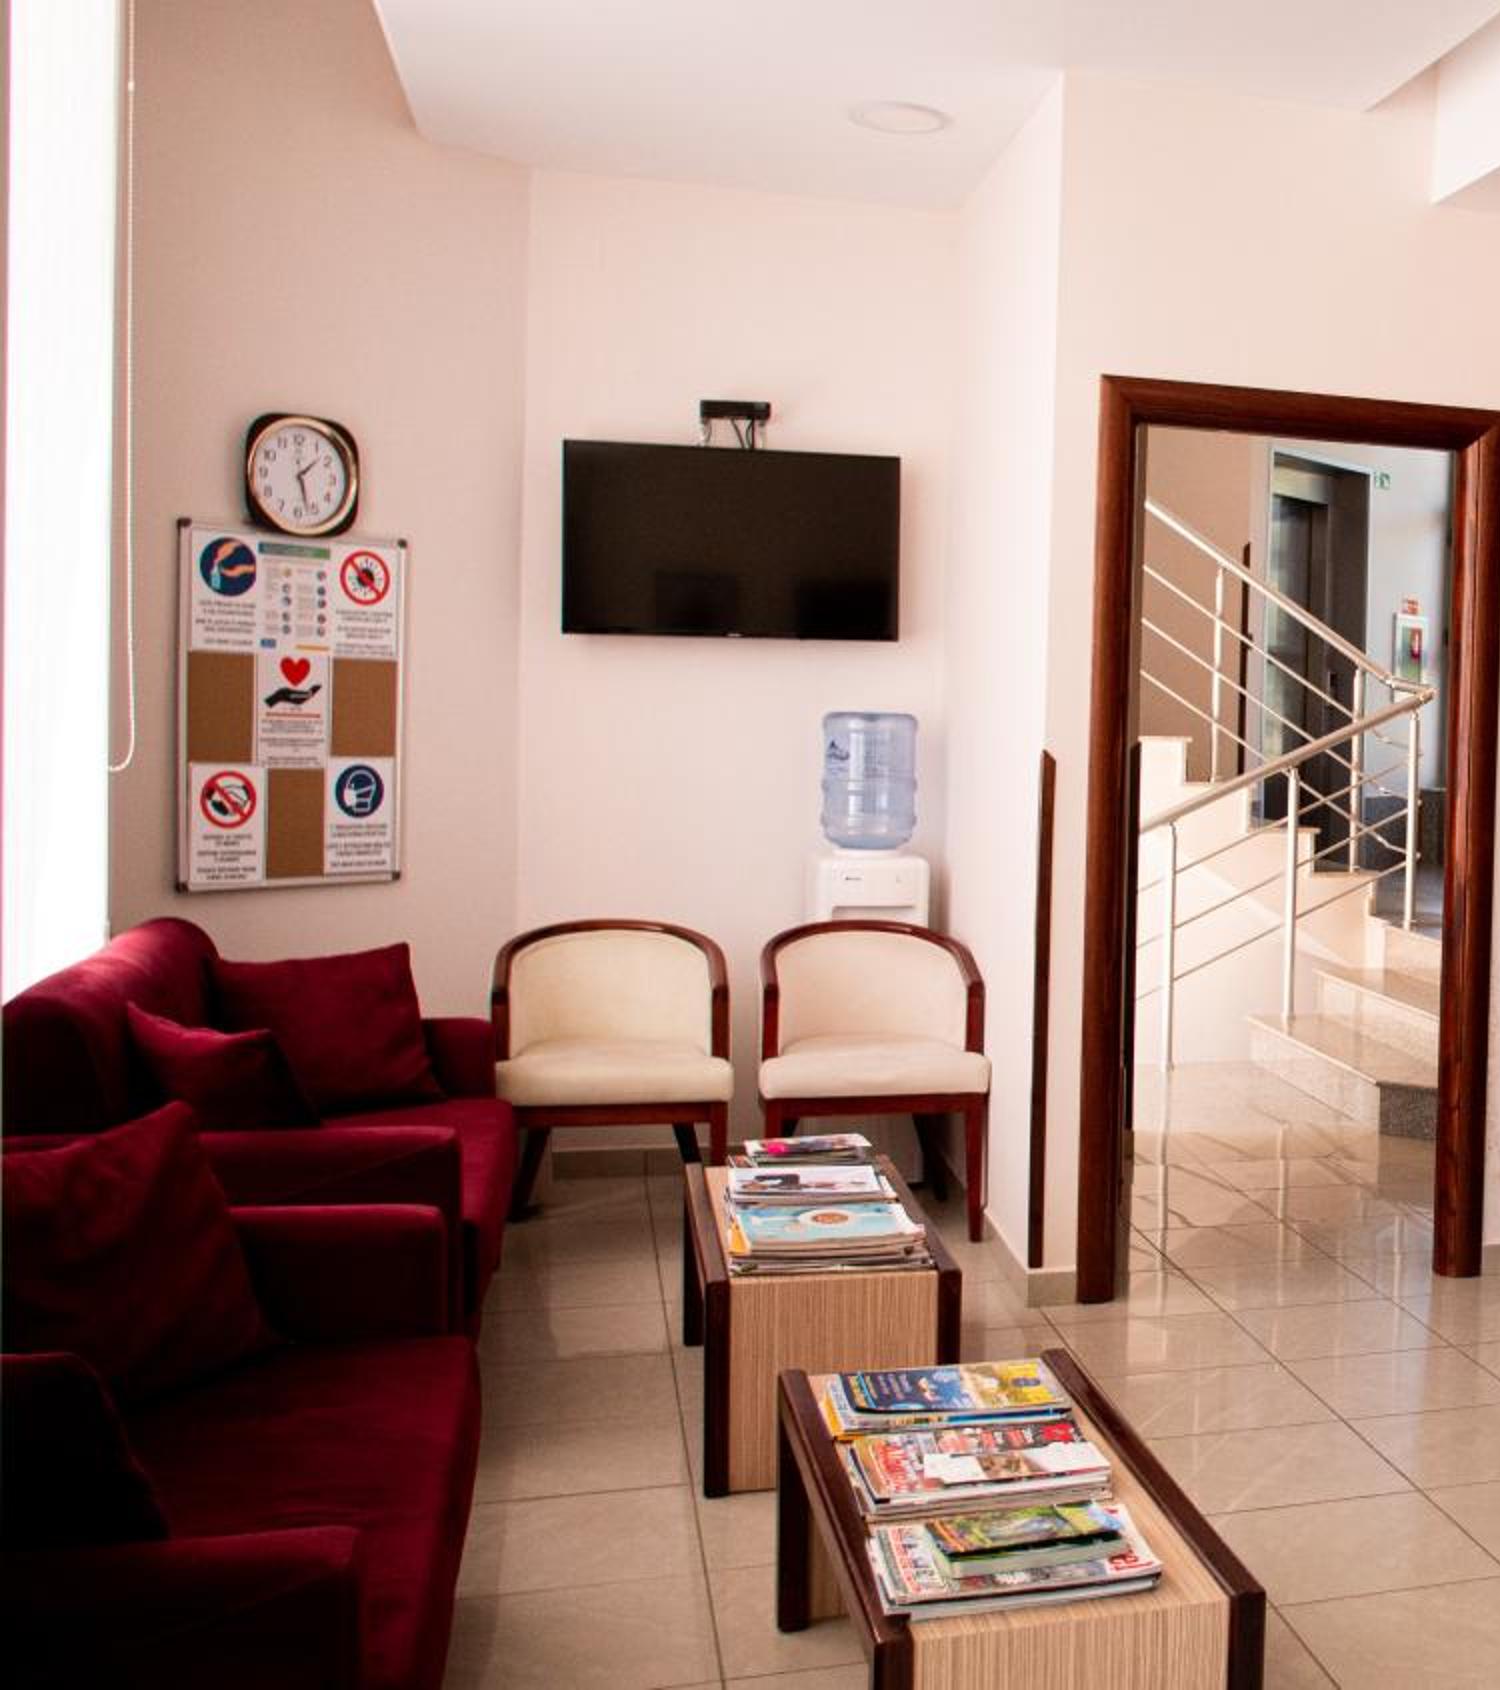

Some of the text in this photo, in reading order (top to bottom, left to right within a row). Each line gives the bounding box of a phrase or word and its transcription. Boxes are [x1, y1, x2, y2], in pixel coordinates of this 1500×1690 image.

[277, 437, 288, 449] 11
[294, 433, 305, 446] 12
[314, 440, 319, 454] 1
[264, 449, 276, 461] 10
[323, 454, 332, 467] 2
[259, 466, 268, 478] 9
[329, 474, 337, 487] 3
[264, 485, 272, 497] 8
[323, 491, 331, 503] 4
[277, 499, 285, 512] 7
[310, 502, 319, 515] 5
[293, 506, 303, 519] 6
